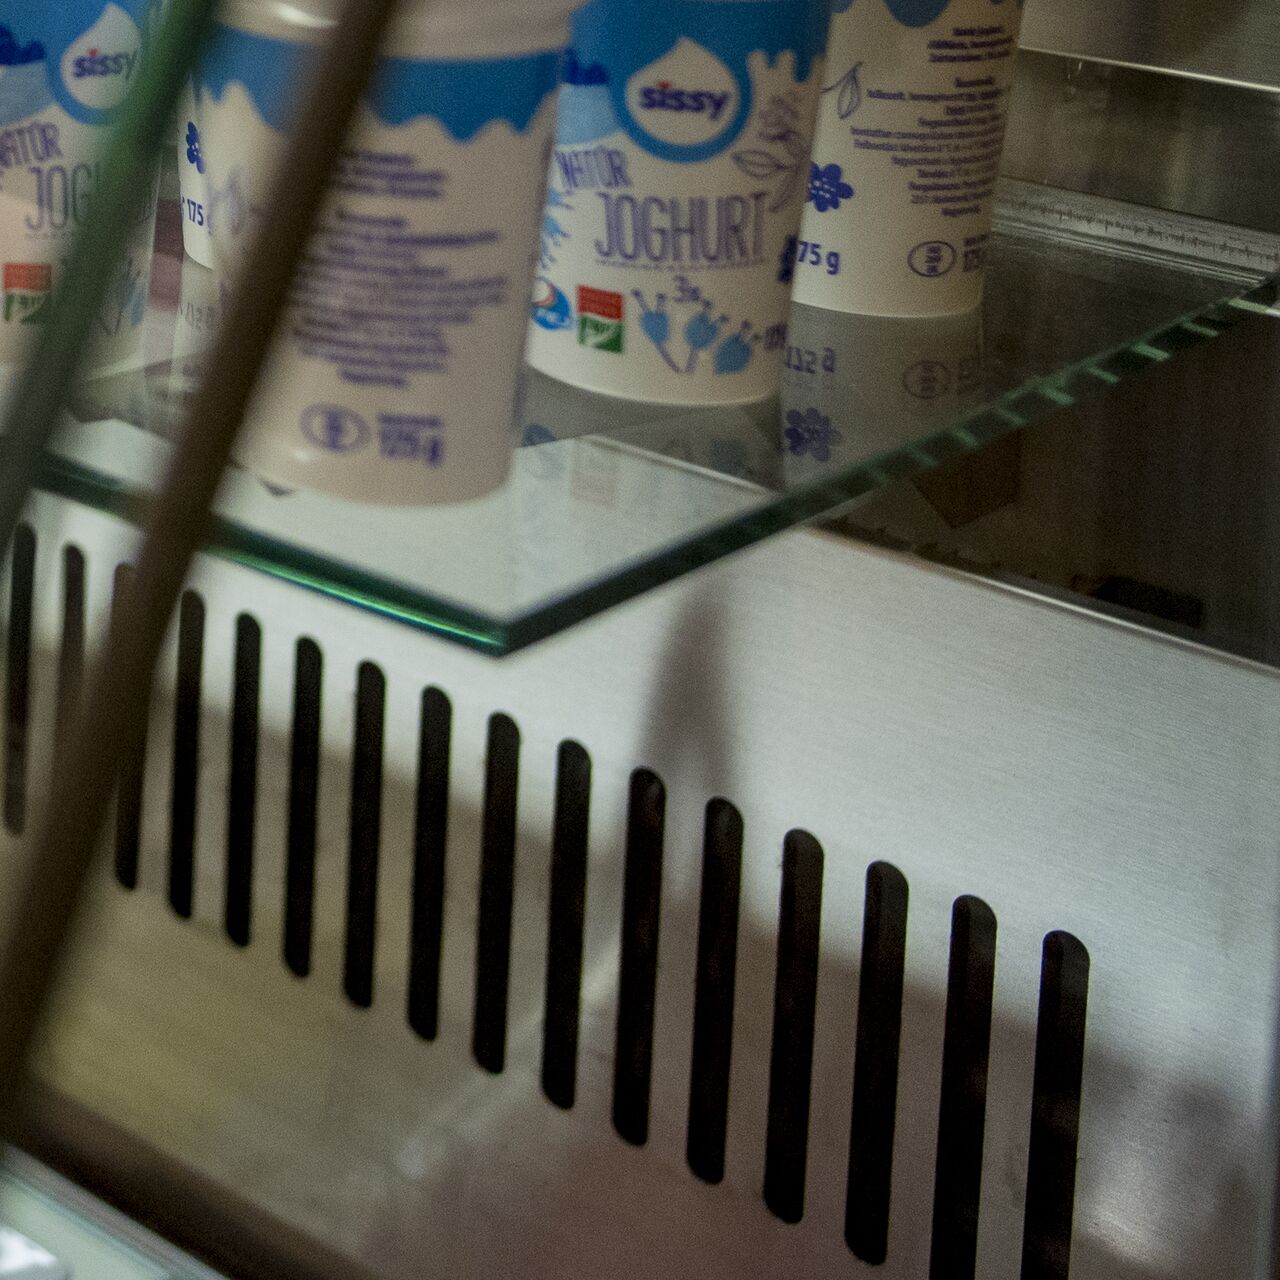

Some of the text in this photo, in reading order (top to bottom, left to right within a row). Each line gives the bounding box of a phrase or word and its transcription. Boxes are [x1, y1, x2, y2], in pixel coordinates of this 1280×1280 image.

[73, 48, 138, 81] sissy
[640, 80, 729, 121] sissy
[187, 198, 204, 227] 175
[593, 191, 769, 262] JOGHURT
[825, 251, 841, 276] g
